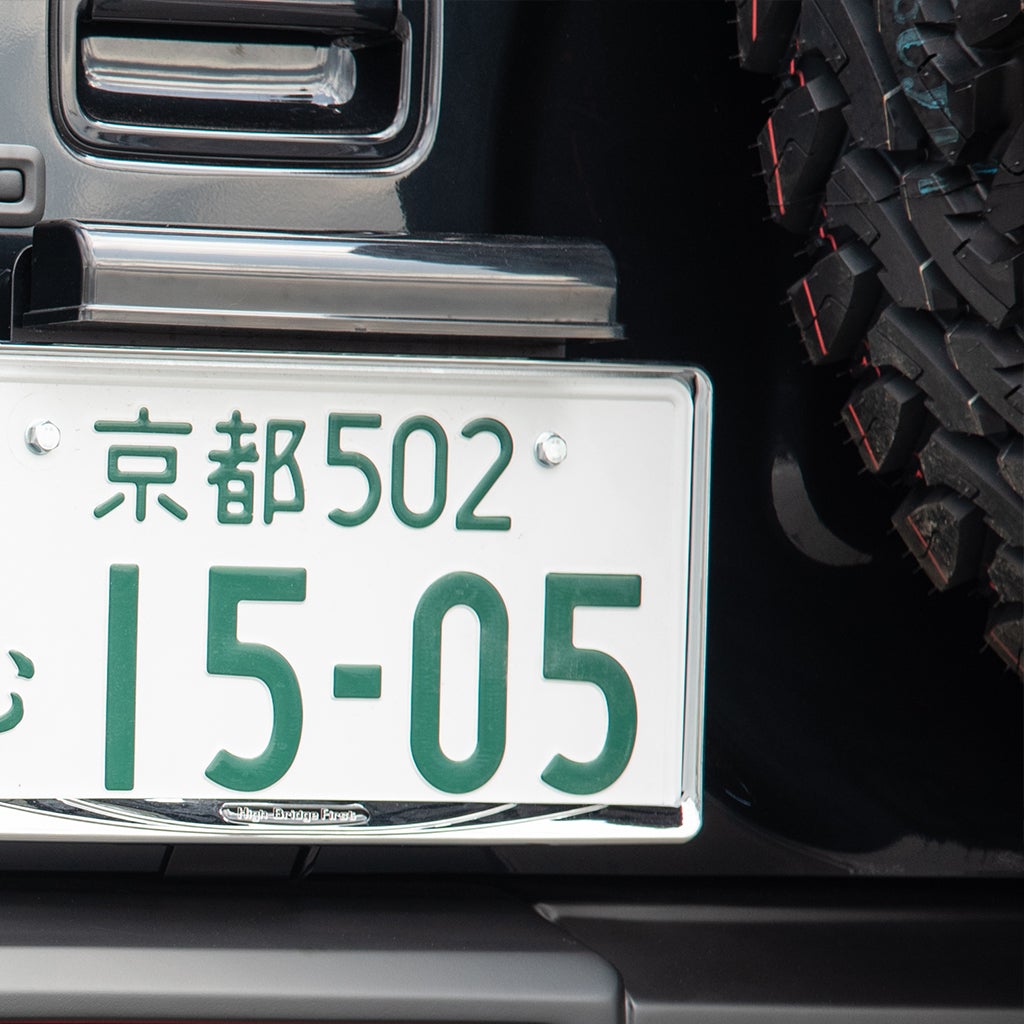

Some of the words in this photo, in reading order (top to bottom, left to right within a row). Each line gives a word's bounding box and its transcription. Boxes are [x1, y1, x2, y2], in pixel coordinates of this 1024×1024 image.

[104, 563, 642, 795] 15-05
[236, 806, 269, 822] High
[272, 806, 320, 823] Bridge
